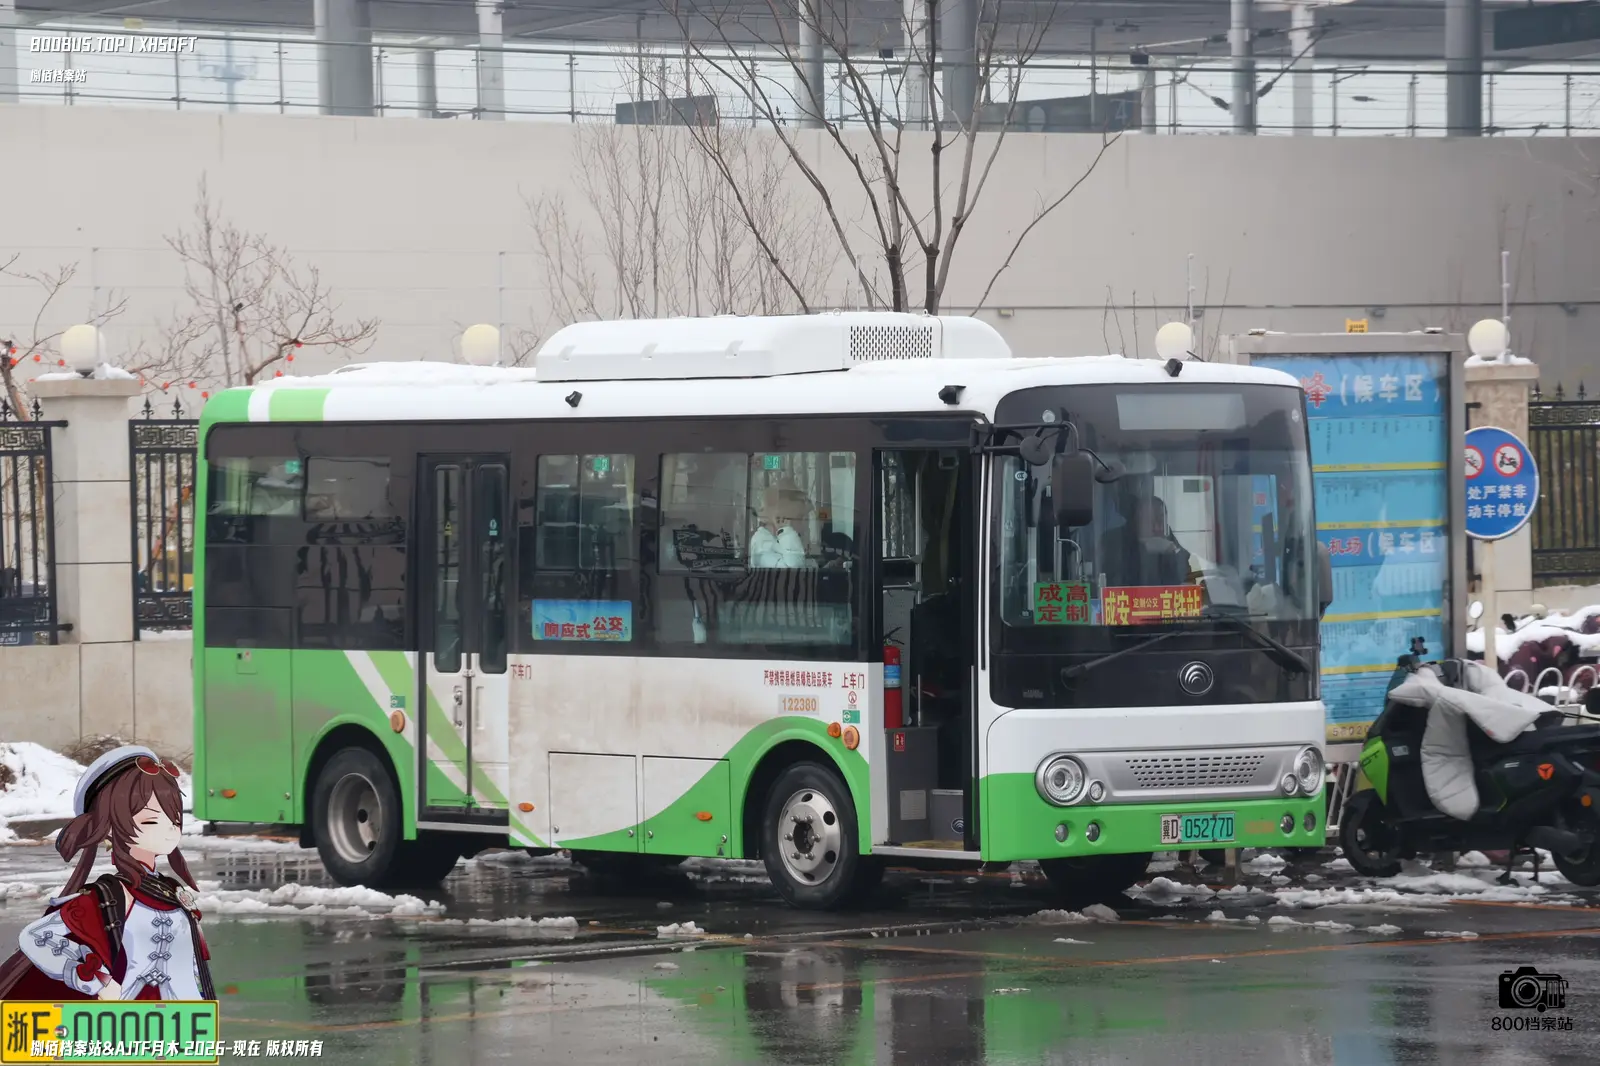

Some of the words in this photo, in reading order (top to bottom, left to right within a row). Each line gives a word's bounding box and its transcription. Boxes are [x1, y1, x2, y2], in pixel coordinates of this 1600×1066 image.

[1038, 584, 1089, 603] 成高
[1038, 604, 1089, 622] 定制
[544, 622, 591, 639] 响应式
[592, 616, 624, 631] 公交
[510, 664, 532, 680] 下车门
[841, 672, 865, 689] 上车门
[782, 697, 817, 711] 122380
[1184, 817, 1234, 839] 05277D
